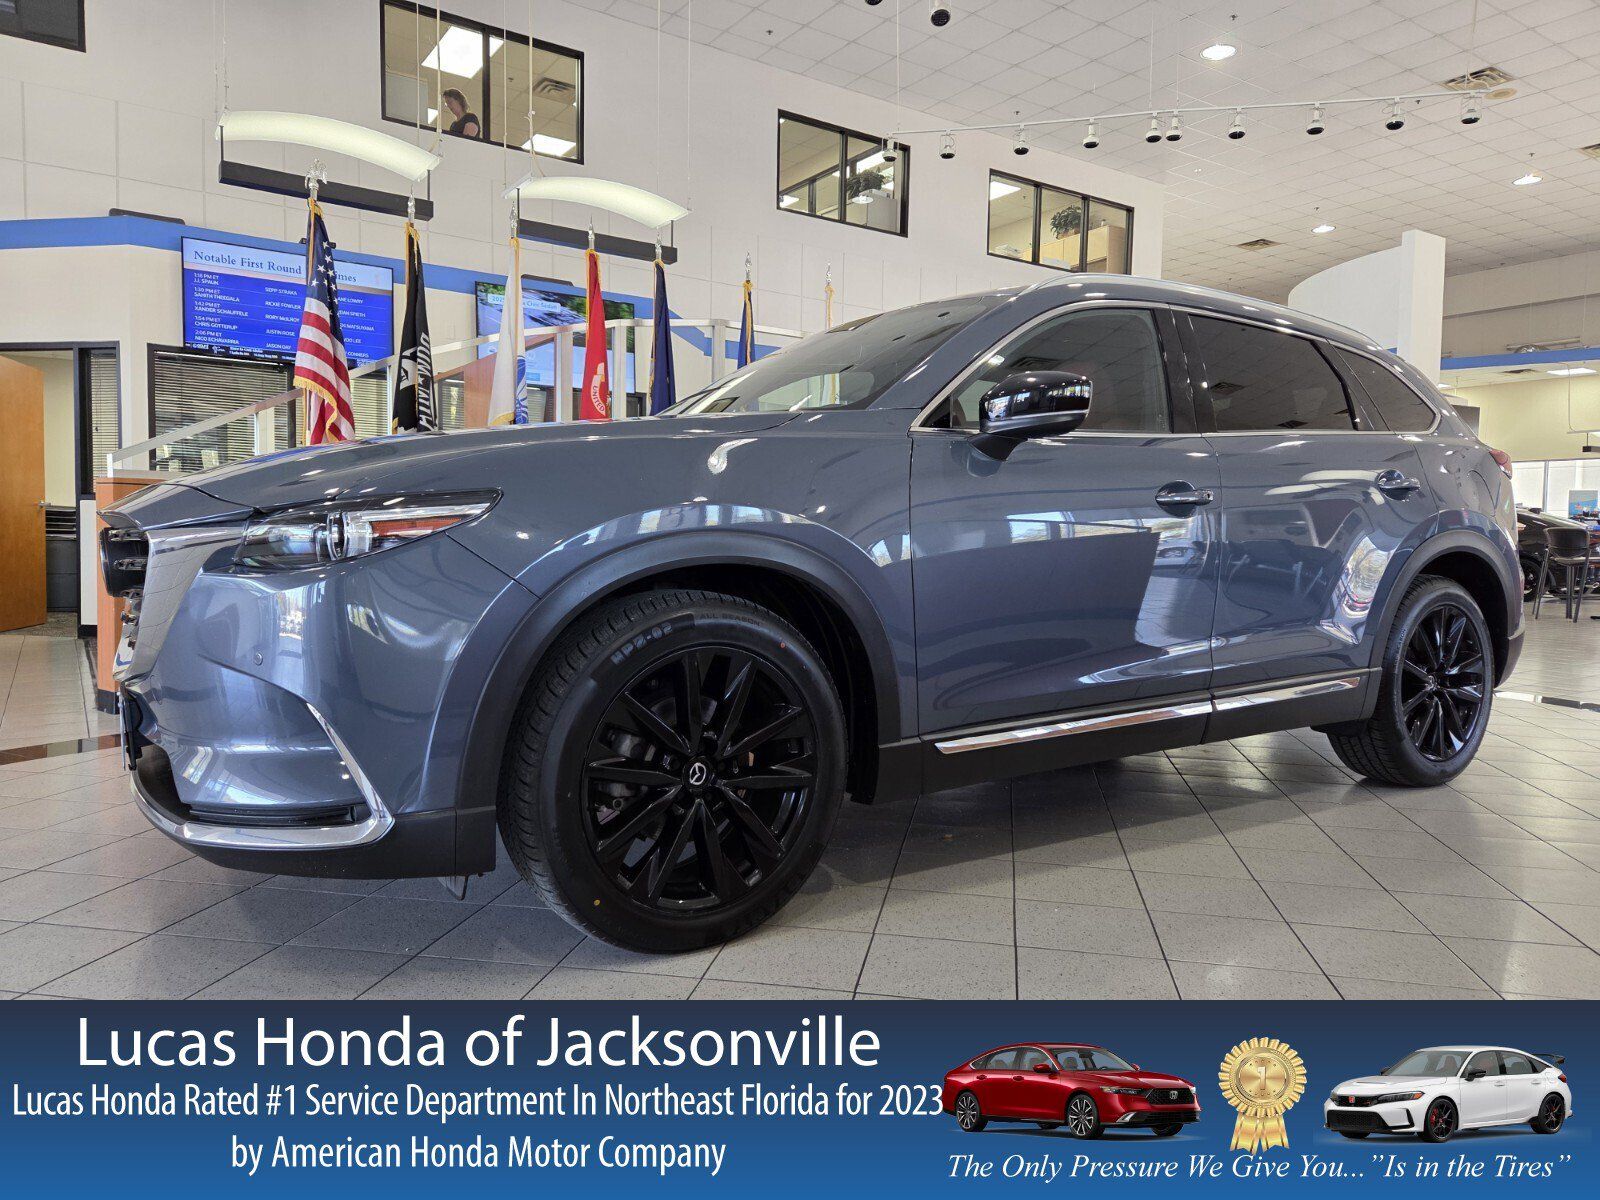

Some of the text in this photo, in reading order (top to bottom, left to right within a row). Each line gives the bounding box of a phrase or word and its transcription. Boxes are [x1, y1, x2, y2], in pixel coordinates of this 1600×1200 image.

[194, 250, 357, 282] Notable First Round imes
[592, 385, 605, 412] UNITED
